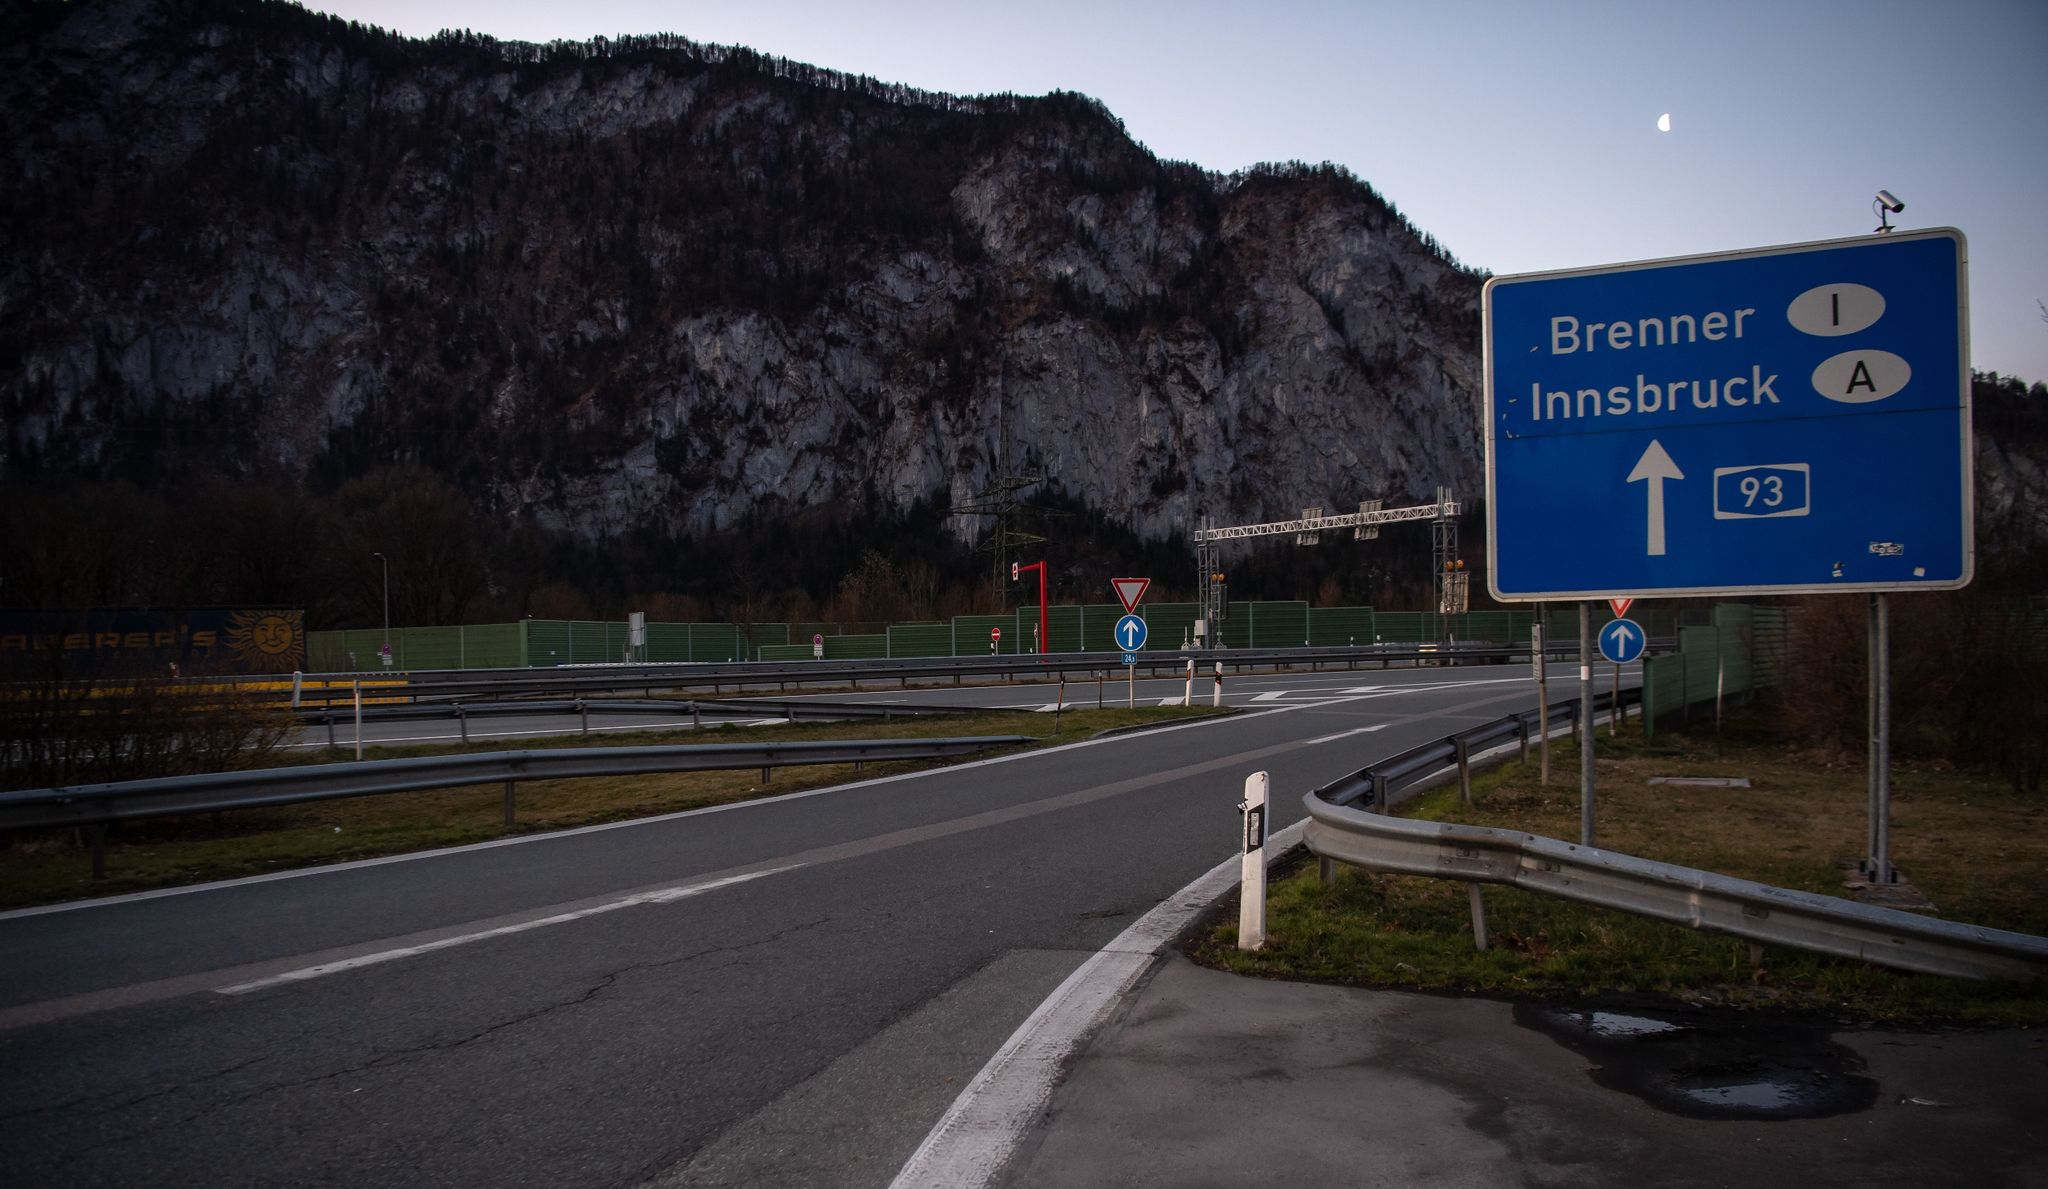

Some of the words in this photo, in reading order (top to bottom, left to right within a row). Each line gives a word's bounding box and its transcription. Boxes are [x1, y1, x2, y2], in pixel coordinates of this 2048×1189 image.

[1551, 308, 1755, 355] Brenner
[1532, 365, 1780, 421] Innsbruck
[1845, 360, 1877, 395] A
[1740, 475, 1784, 508] 93
